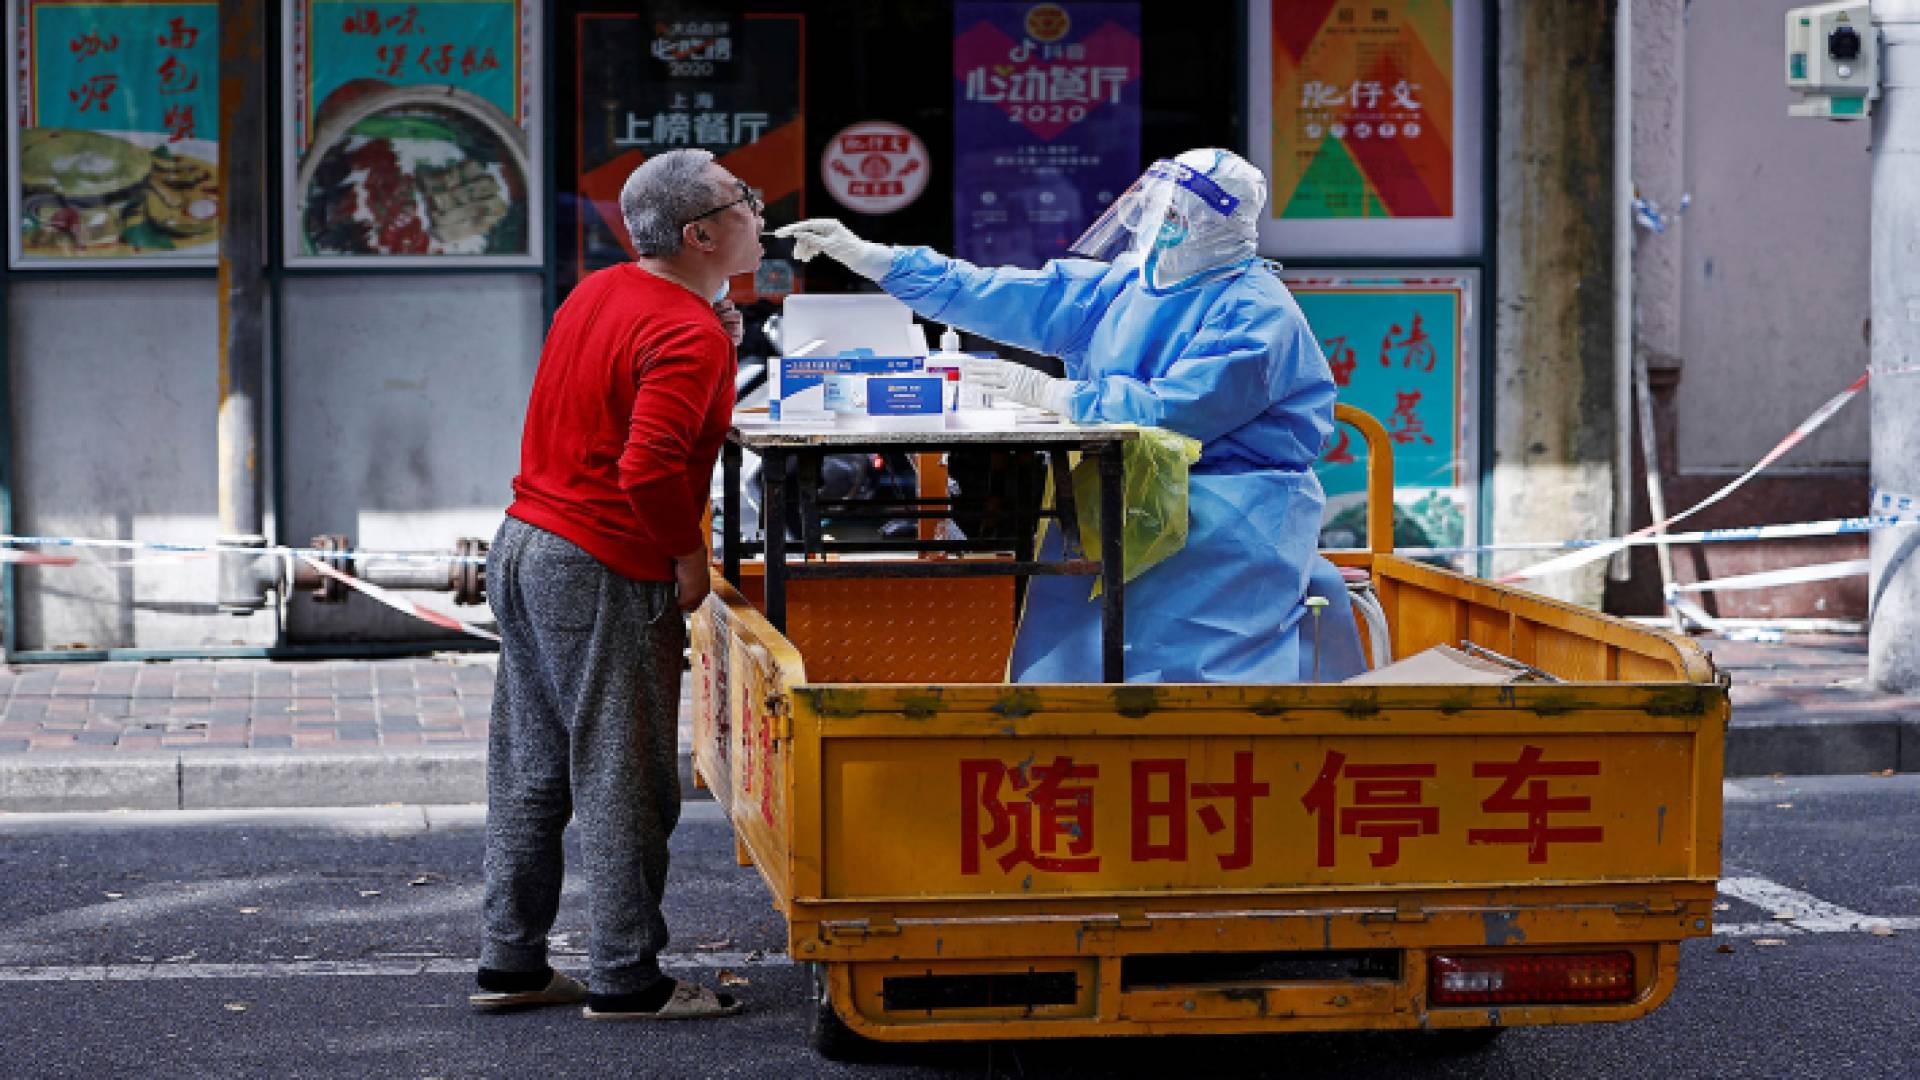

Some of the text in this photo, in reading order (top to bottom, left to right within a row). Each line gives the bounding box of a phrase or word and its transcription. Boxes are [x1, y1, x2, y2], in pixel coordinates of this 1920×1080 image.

[614, 111, 769, 145] 上榜餐厅
[1009, 105, 1087, 122] 2020
[958, 744, 1605, 876] 随时停车
